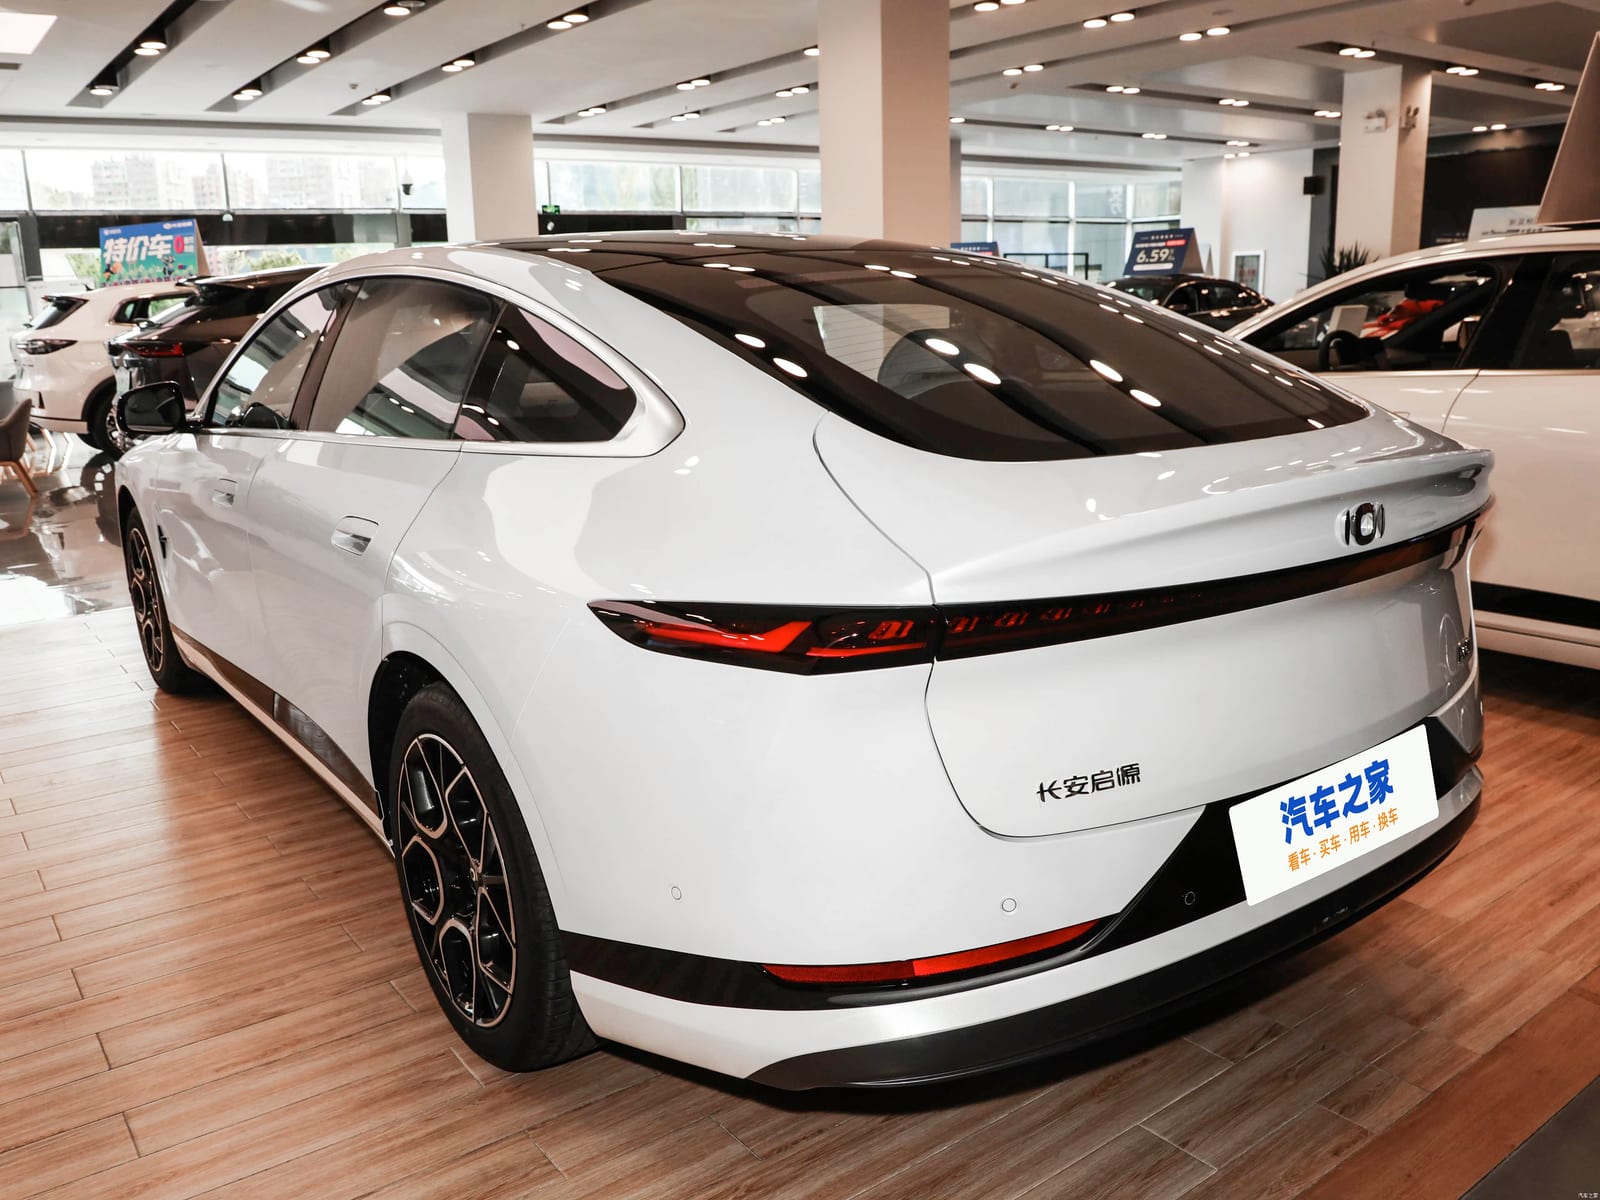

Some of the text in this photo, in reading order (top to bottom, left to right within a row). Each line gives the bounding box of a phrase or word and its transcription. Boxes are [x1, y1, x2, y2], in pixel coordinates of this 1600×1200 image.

[103, 233, 173, 266] 特价车
[1136, 248, 1170, 264] 6.59
[1036, 762, 1141, 803] 长安启源
[1279, 758, 1394, 845] 汽车之家
